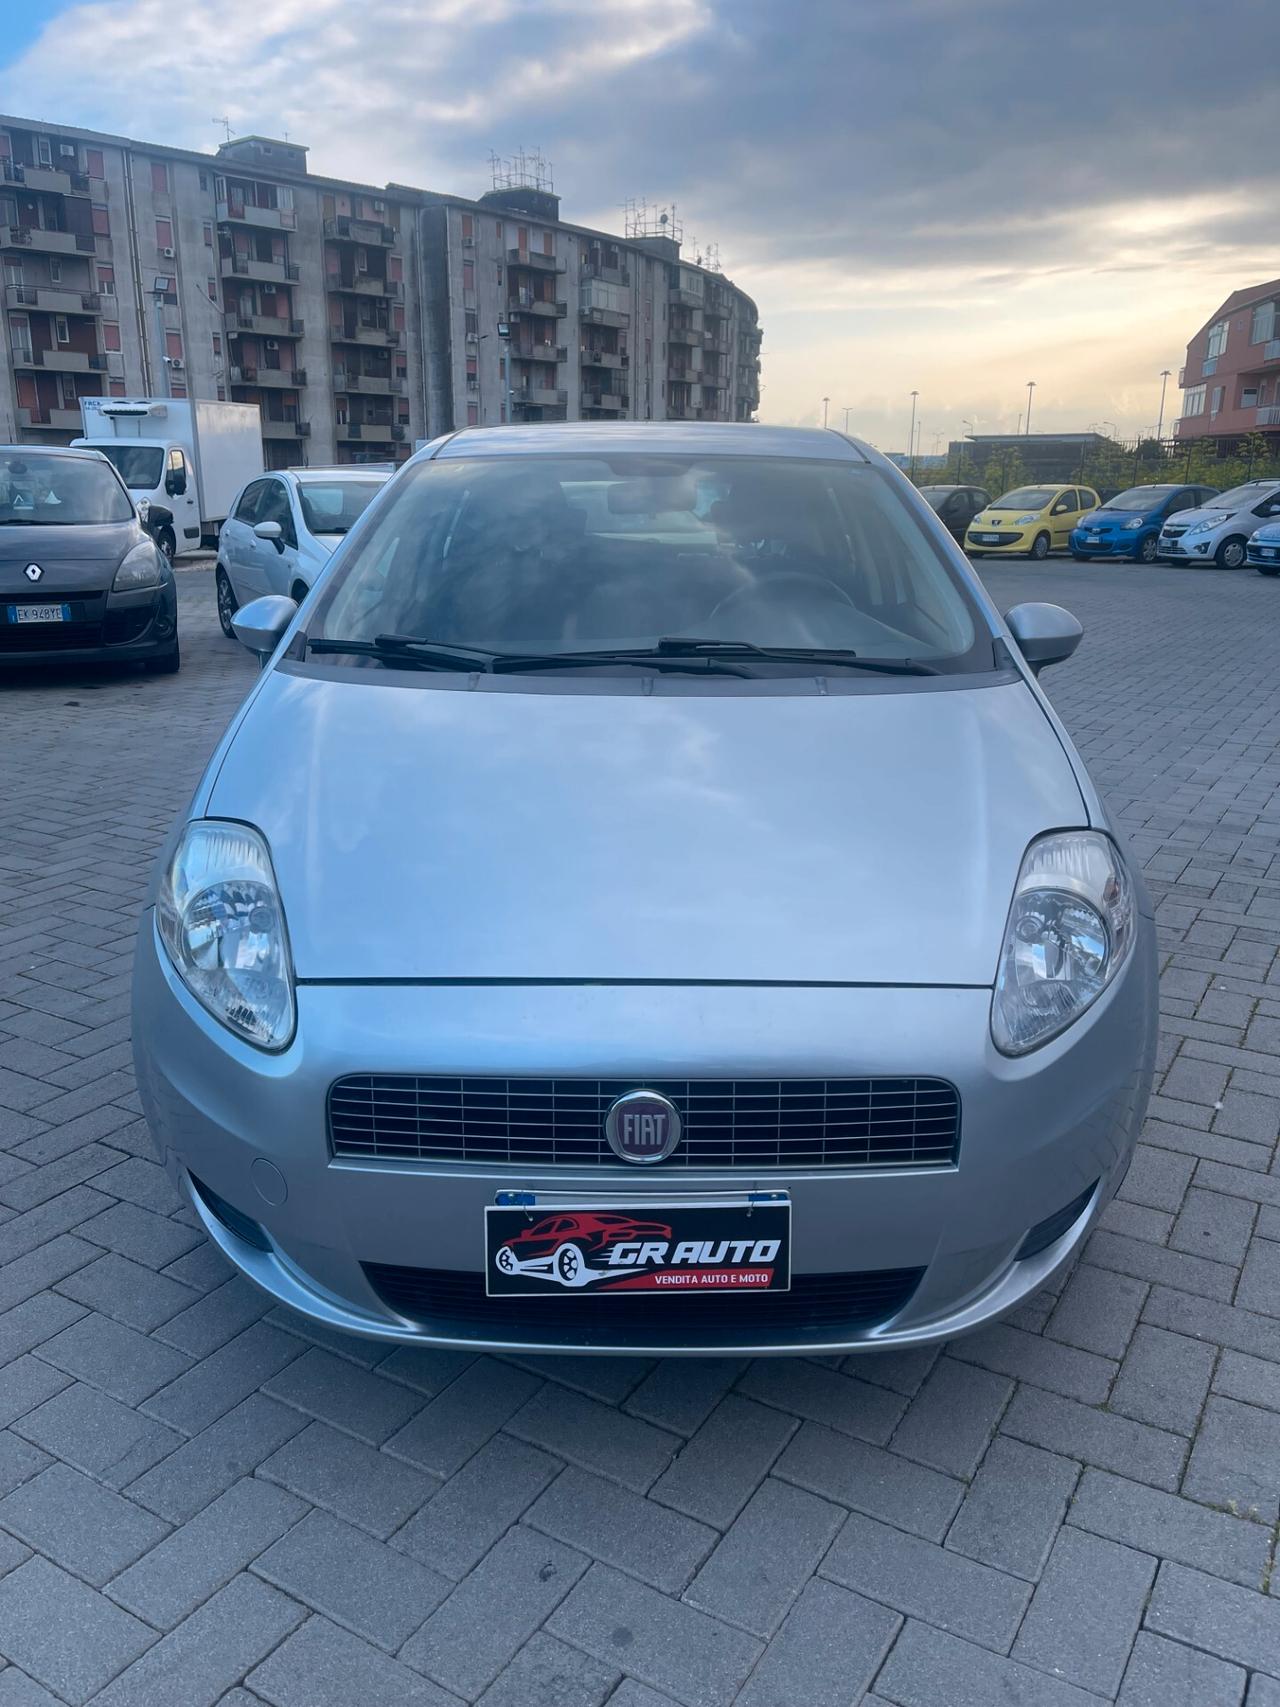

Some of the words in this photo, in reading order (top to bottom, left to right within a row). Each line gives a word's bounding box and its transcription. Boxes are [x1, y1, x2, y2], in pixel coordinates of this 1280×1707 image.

[18, 609, 29, 620] EK
[623, 1114, 666, 1145] FIAT
[608, 1241, 669, 1265] GR
[670, 1239, 782, 1265] AUTO
[655, 1274, 698, 1285] VENDITA
[701, 1274, 728, 1284] AUTO
[731, 1274, 737, 1284] E
[739, 1273, 769, 1284] MOTO
